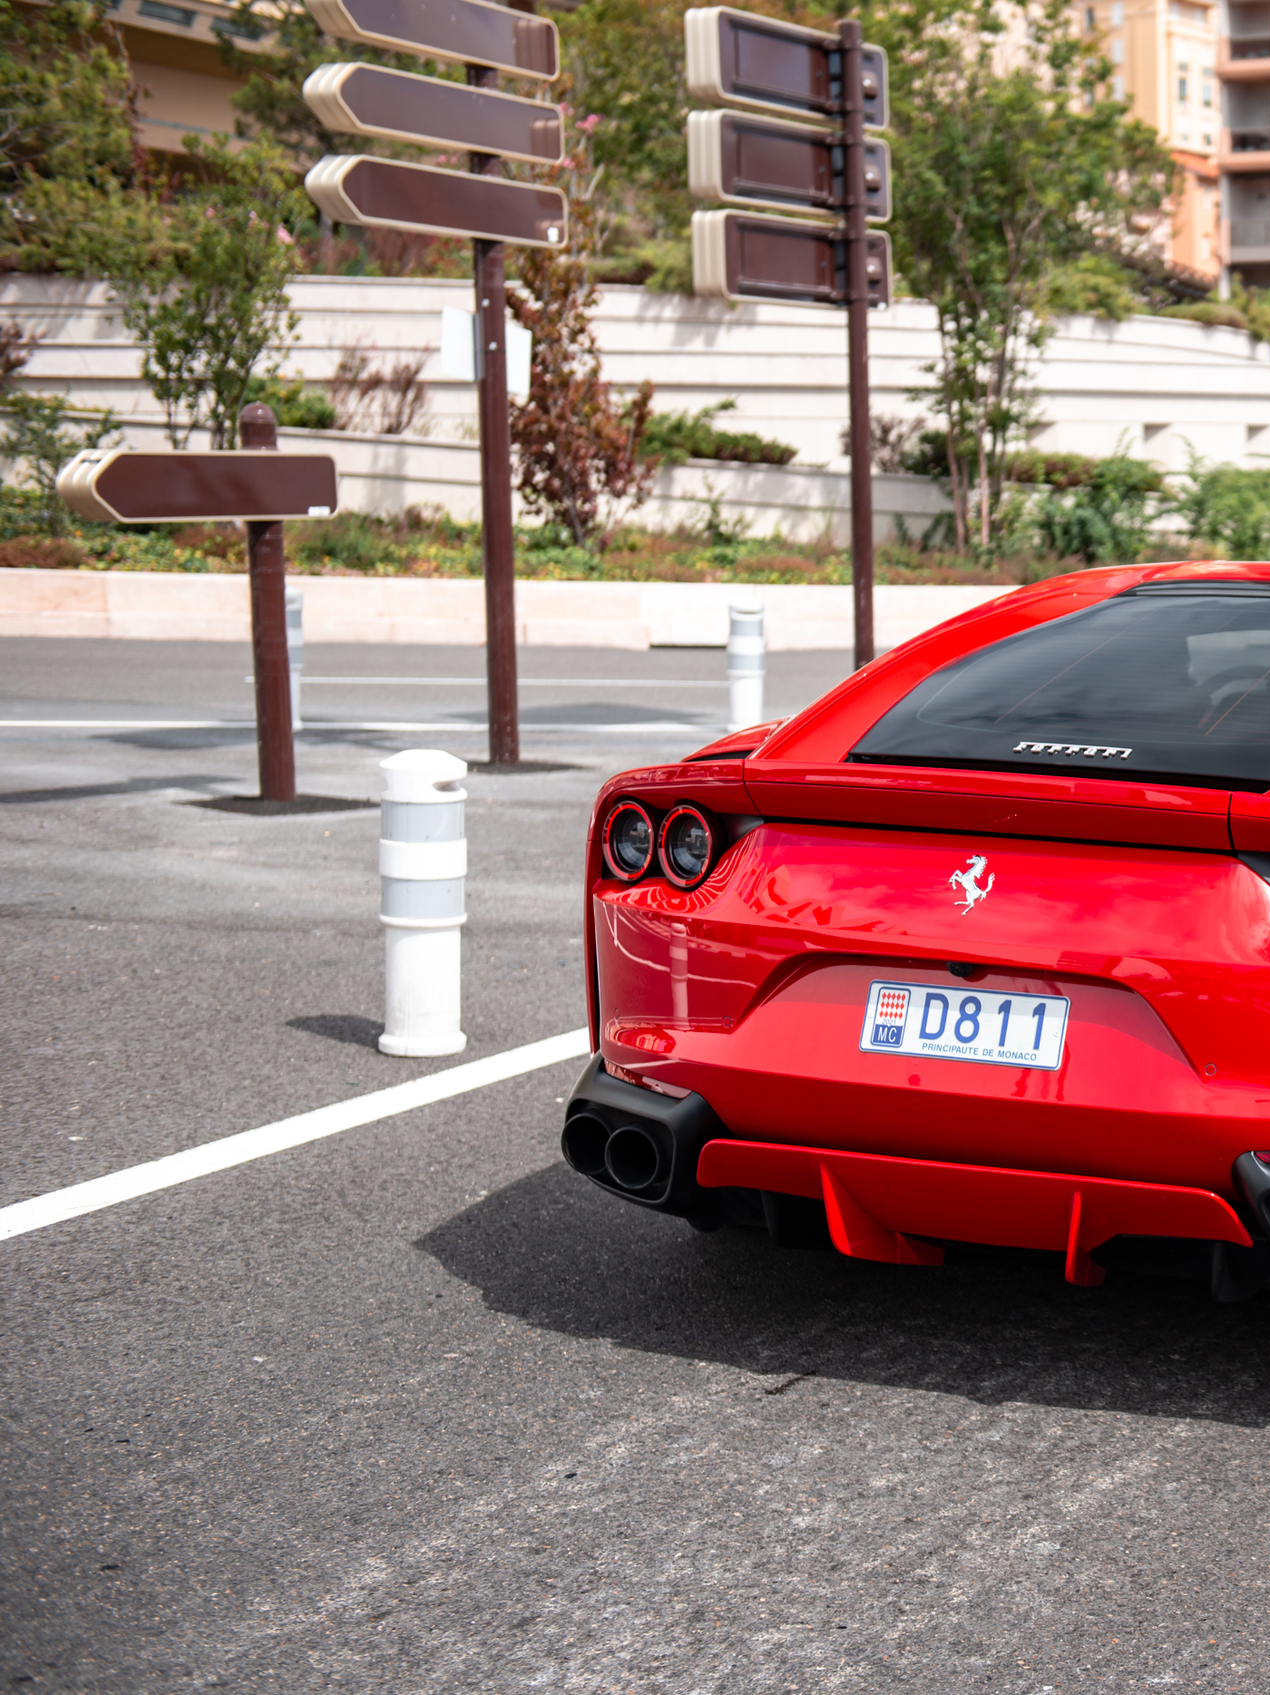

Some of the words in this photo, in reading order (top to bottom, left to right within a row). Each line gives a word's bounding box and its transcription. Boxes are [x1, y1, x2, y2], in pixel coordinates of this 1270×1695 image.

[918, 992, 1047, 1050] D811
[877, 1026, 897, 1043] MC
[921, 1042, 979, 1056] PRINCIPAUTE
[982, 1048, 994, 1058] DE
[997, 1050, 1037, 1062] MONACO
